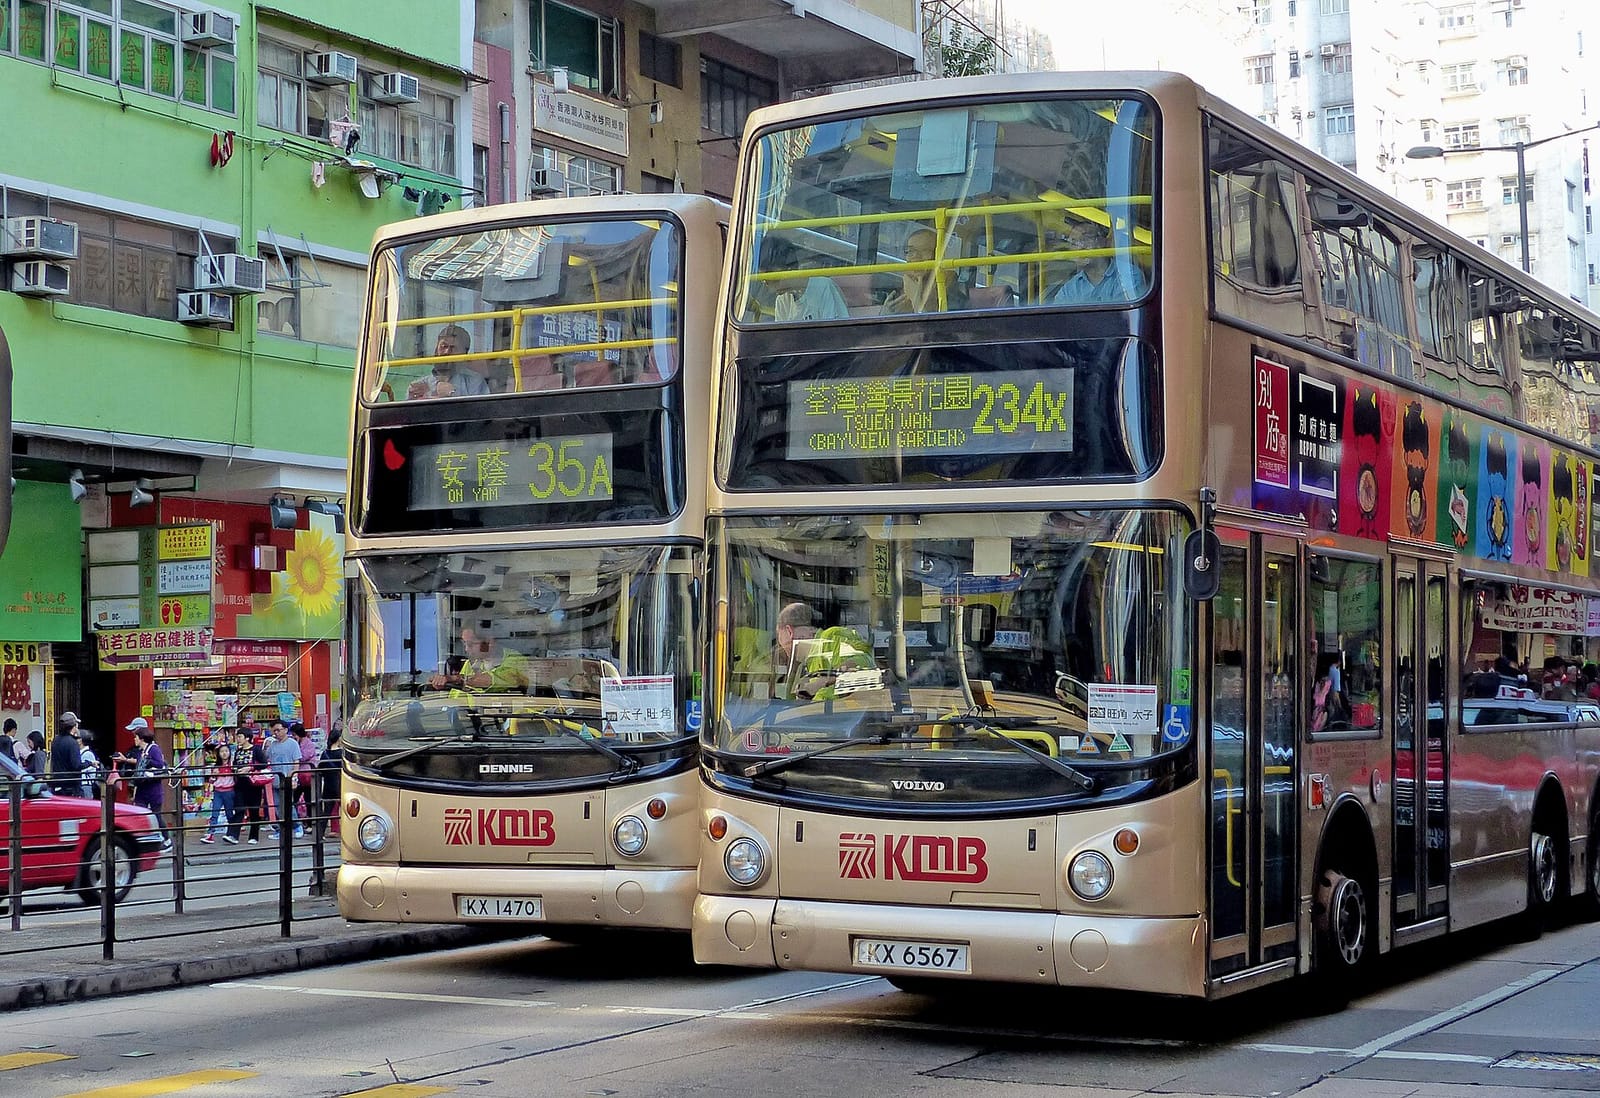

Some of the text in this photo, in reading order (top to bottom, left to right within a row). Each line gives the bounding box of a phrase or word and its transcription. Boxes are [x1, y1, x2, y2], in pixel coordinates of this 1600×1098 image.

[805, 376, 972, 416] 荃灣灣景花園
[844, 411, 933, 430] TSUEN WAN
[808, 428, 967, 451] (BAYVIEW GARDEN)
[435, 441, 613, 498] 安蔭 35A
[449, 487, 498, 502] ON YAM
[3, 643, 37, 663] $50
[479, 764, 534, 773] DENNIS
[891, 779, 946, 791] VOLVO
[478, 809, 556, 846] KMB
[884, 834, 989, 884] KMB
[466, 899, 536, 916] KX 1470
[867, 943, 960, 968] KX 6567
